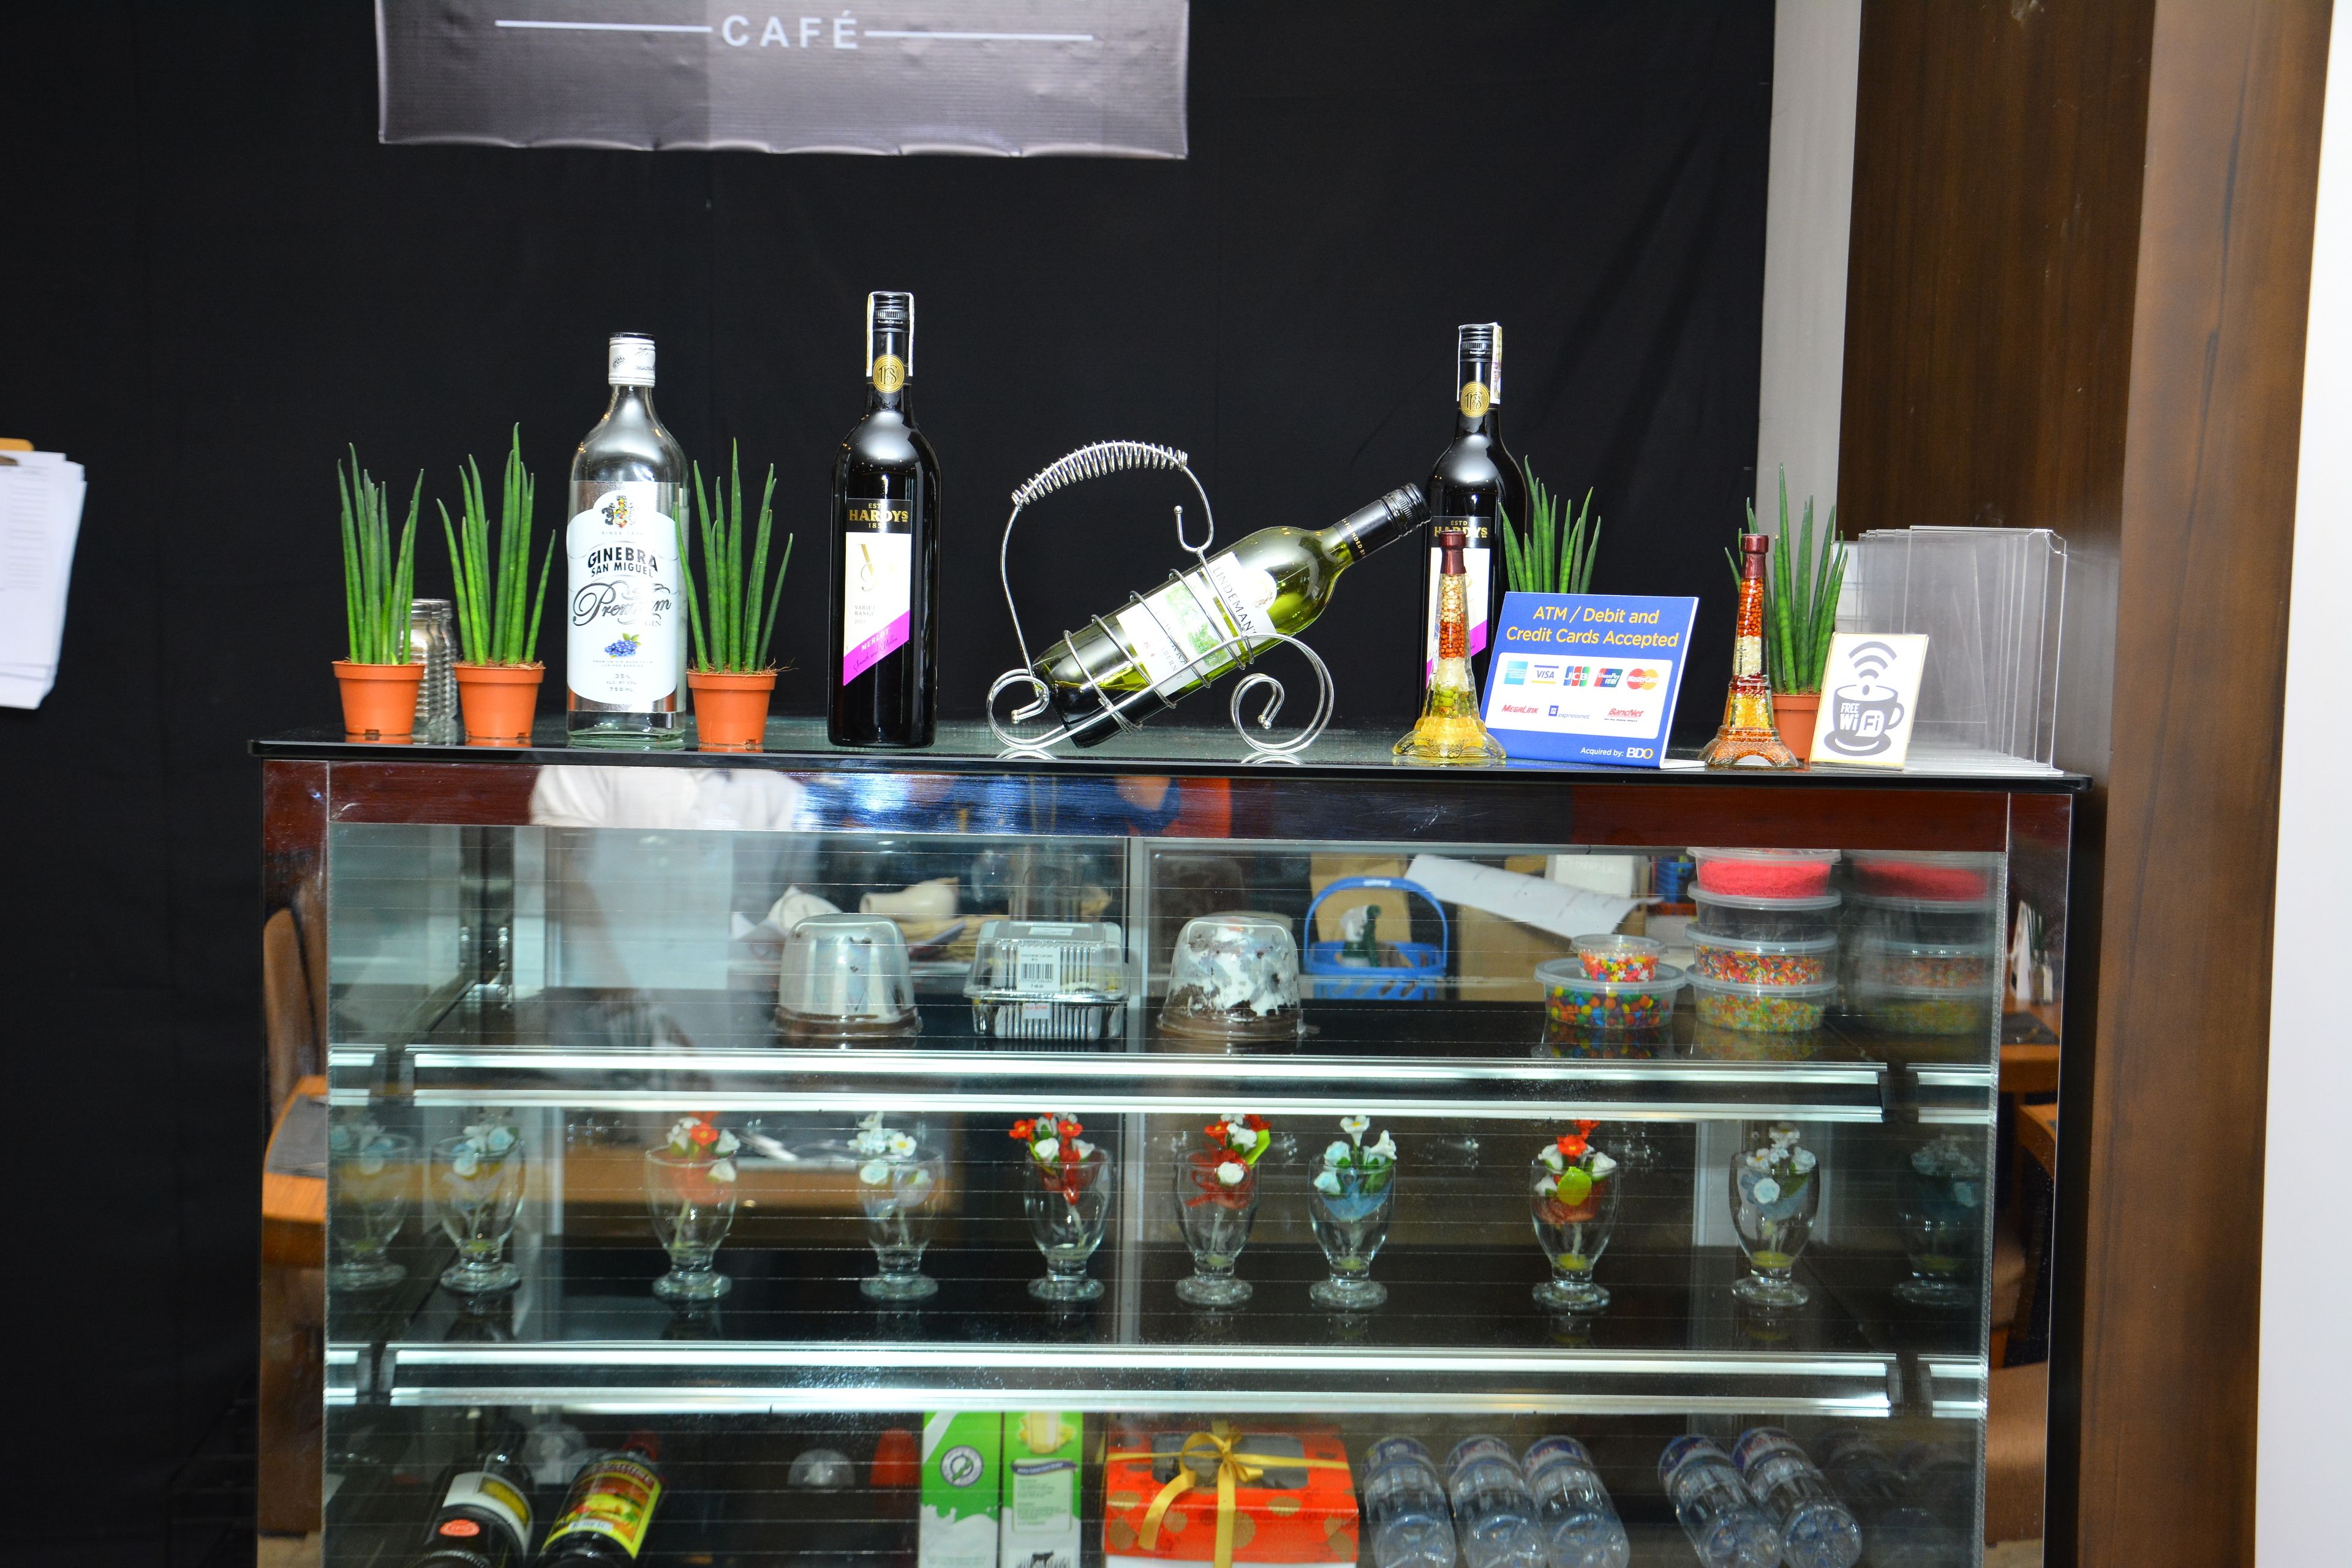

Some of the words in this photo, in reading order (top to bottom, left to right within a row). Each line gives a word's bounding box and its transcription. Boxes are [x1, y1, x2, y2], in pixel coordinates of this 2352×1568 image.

[722, 9, 859, 50] CAFÉ
[849, 509, 909, 523] HARDYS
[588, 546, 658, 573] GINEBRA
[590, 562, 609, 578] SAN
[613, 562, 654, 578] MIGUEL
[573, 582, 672, 627] Premm
[1533, 606, 1568, 621] ATM
[1583, 608, 1626, 624] Debit
[1629, 609, 1660, 624] and
[861, 627, 891, 652] MERLOT
[1506, 626, 1551, 643] Credit
[1556, 628, 1599, 644] Cards
[1602, 630, 1679, 649] Accepted
[1536, 670, 1555, 679] VISA
[1564, 671, 1588, 681] JCB
[1608, 707, 1645, 717] BancNet
[1841, 702, 1860, 714] FREE
[1580, 747, 1613, 758] Acquired
[1614, 748, 1624, 758] by:
[1626, 747, 1654, 760] BDO
